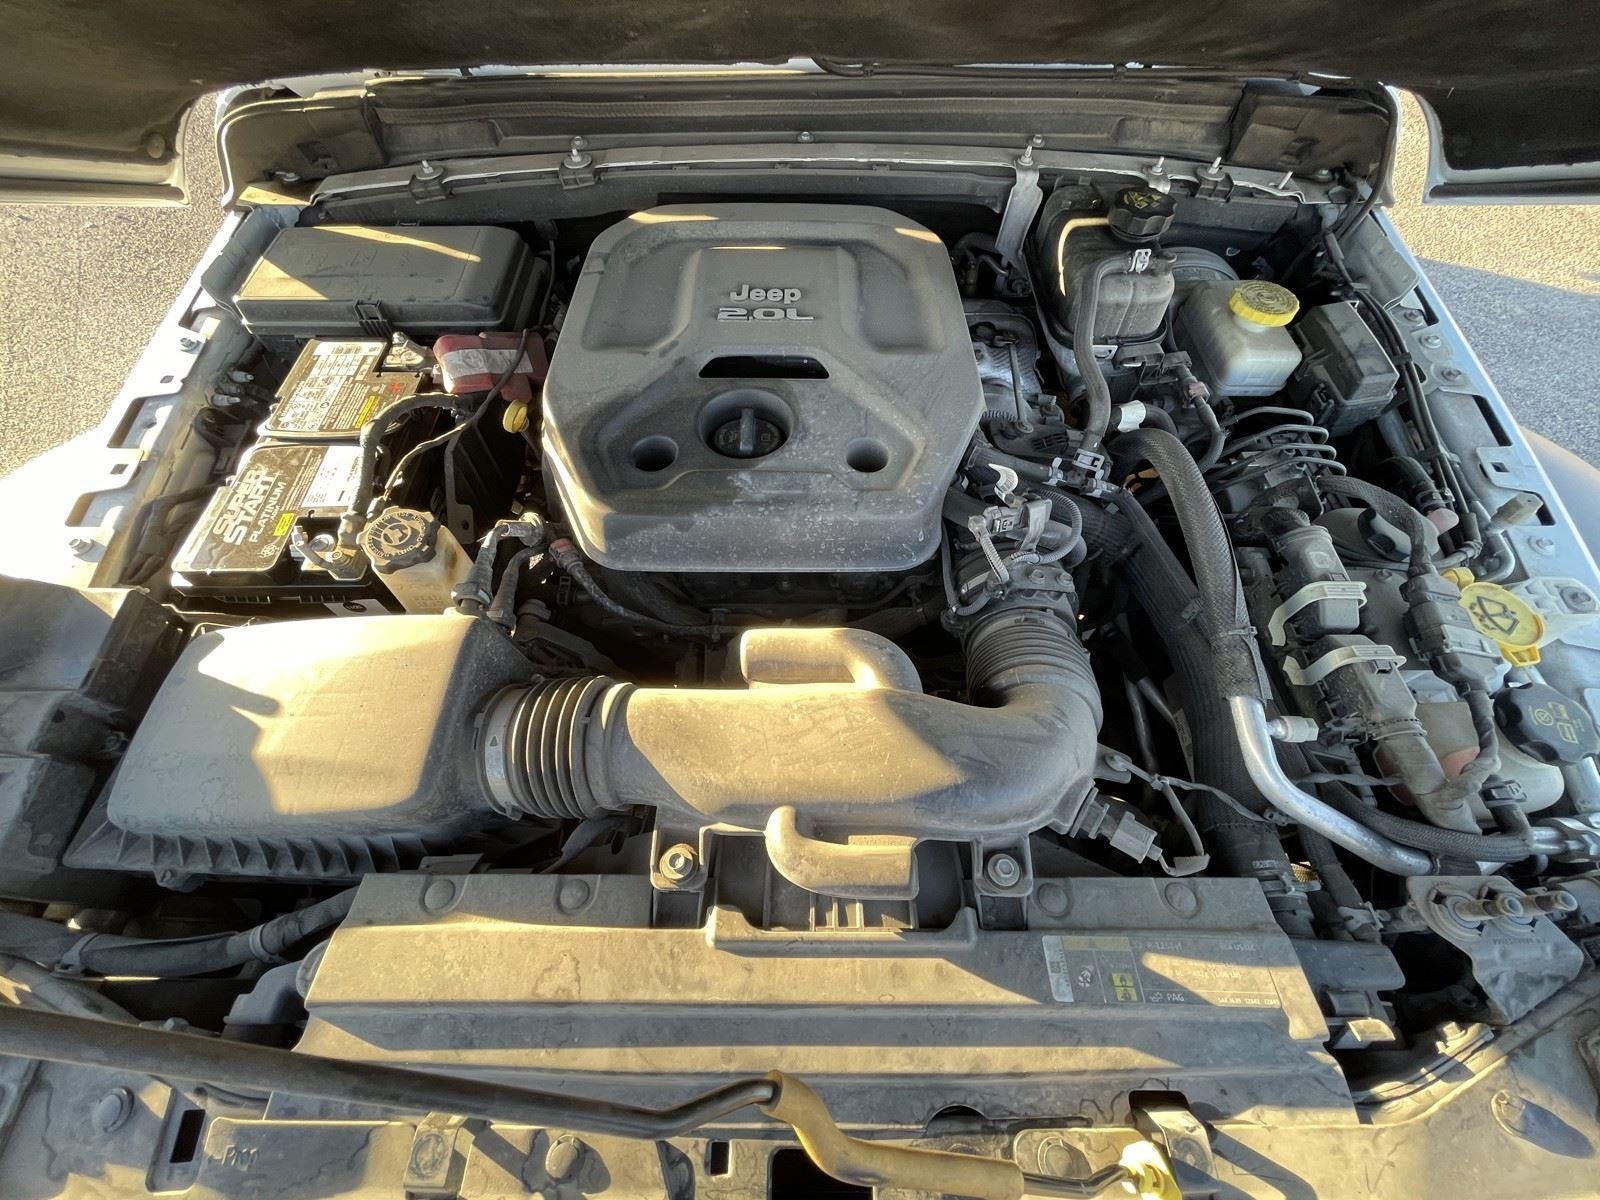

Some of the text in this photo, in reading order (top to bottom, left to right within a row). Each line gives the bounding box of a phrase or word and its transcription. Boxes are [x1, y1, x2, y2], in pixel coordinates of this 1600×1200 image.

[717, 307, 814, 321] 2.0L
[729, 284, 802, 305] Jeep
[212, 468, 262, 535] SUPER
[222, 471, 277, 546] START
[248, 481, 287, 543] PLATINUM
